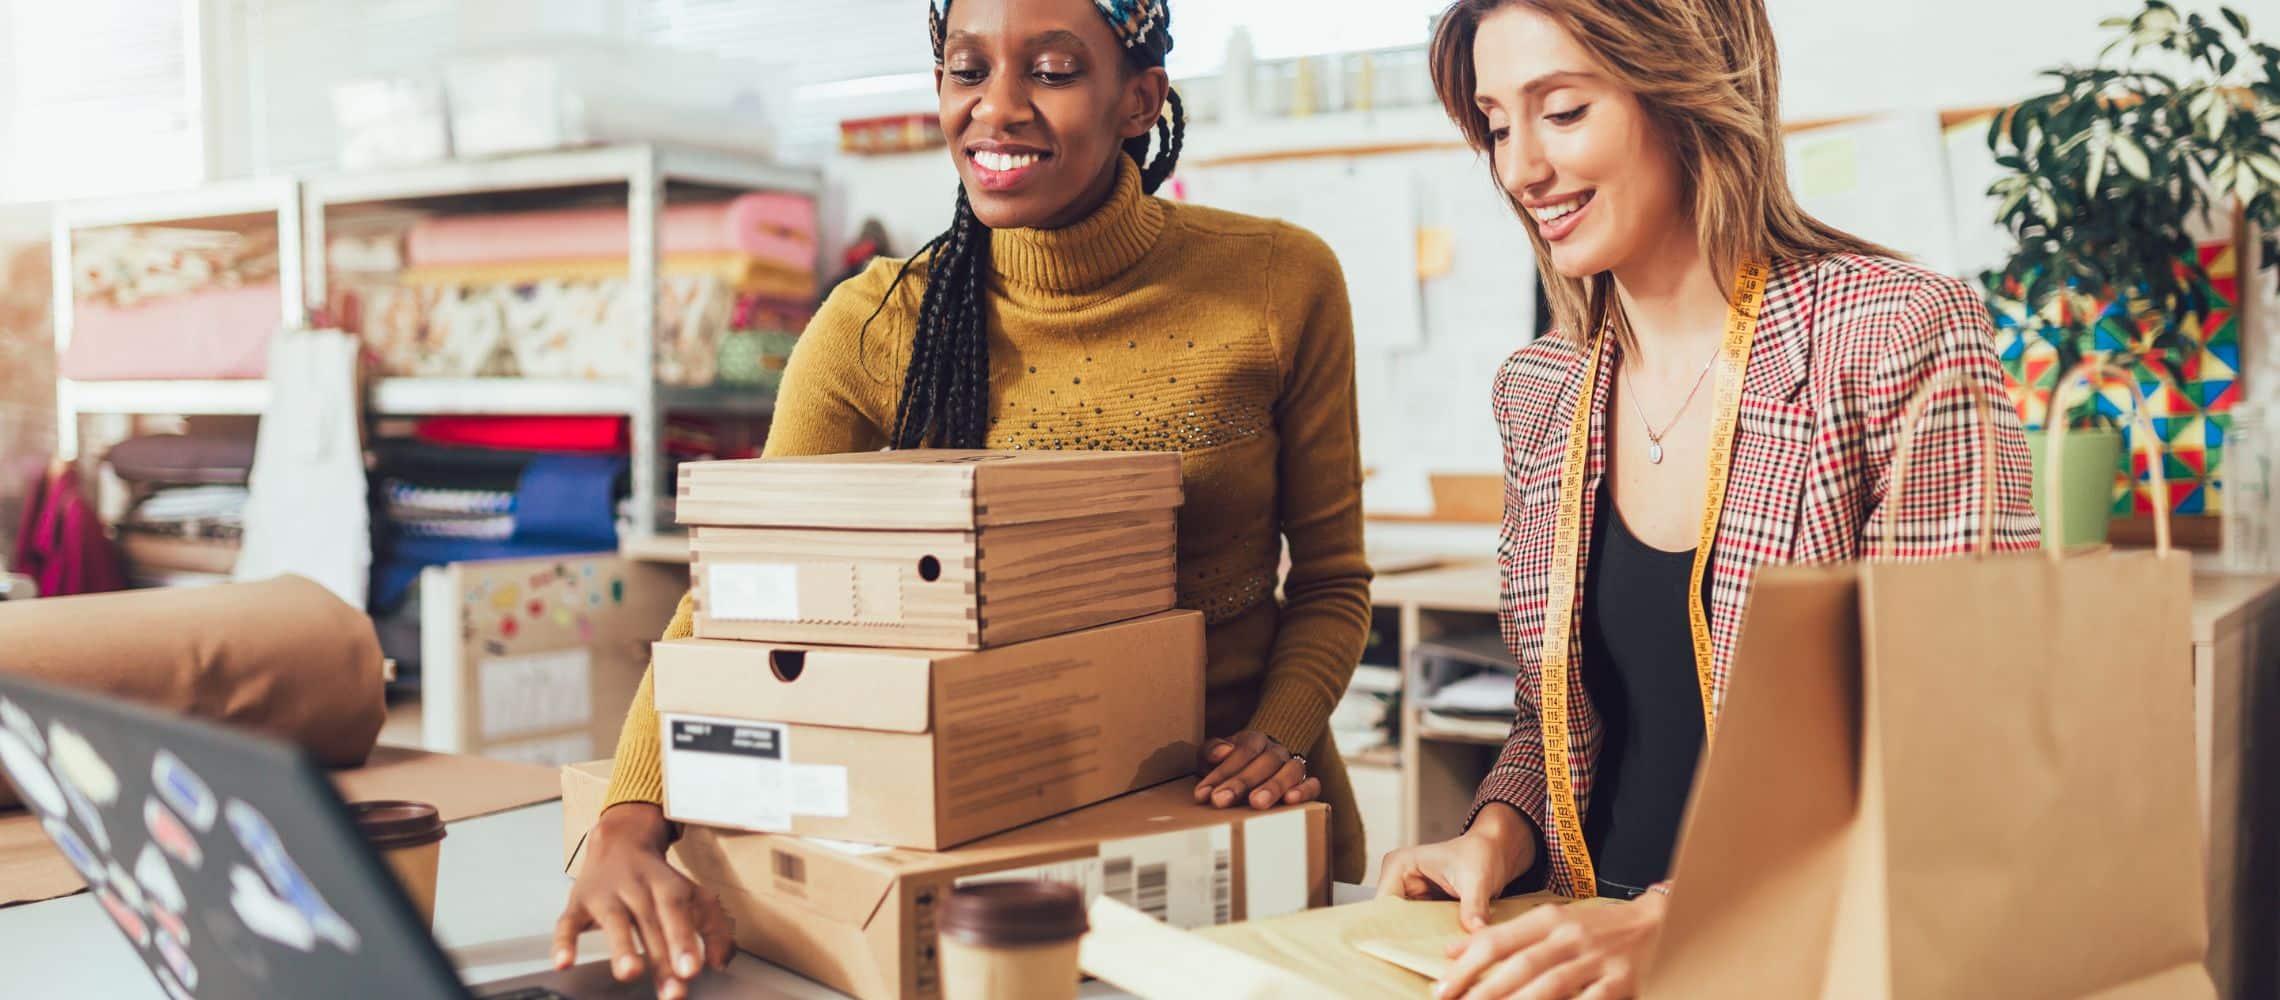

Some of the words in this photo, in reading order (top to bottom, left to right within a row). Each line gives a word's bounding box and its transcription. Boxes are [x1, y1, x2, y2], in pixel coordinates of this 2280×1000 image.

[1746, 280, 1756, 289] 61
[1743, 293, 1753, 303] 60
[1737, 321, 1747, 331] 58
[1734, 335, 1744, 344] 57
[1558, 544, 1568, 553] 103
[1556, 558, 1567, 567] 104
[1547, 640, 1559, 650] 110
[1547, 655, 1557, 664] 111
[1546, 669, 1558, 678] 112
[1546, 683, 1558, 692] 113
[1547, 697, 1558, 706] 114
[1547, 711, 1558, 720] 115
[1548, 725, 1559, 734] 116
[1549, 739, 1559, 748] 117
[1549, 753, 1560, 762] 118
[1550, 767, 1561, 776] 119
[1552, 780, 1563, 790] 120
[1555, 793, 1566, 802] 121
[1557, 806, 1569, 816] 122
[1560, 820, 1572, 828] 123
[1563, 832, 1575, 842] 124
[1567, 844, 1579, 853] 125
[1575, 868, 1585, 876] 127
